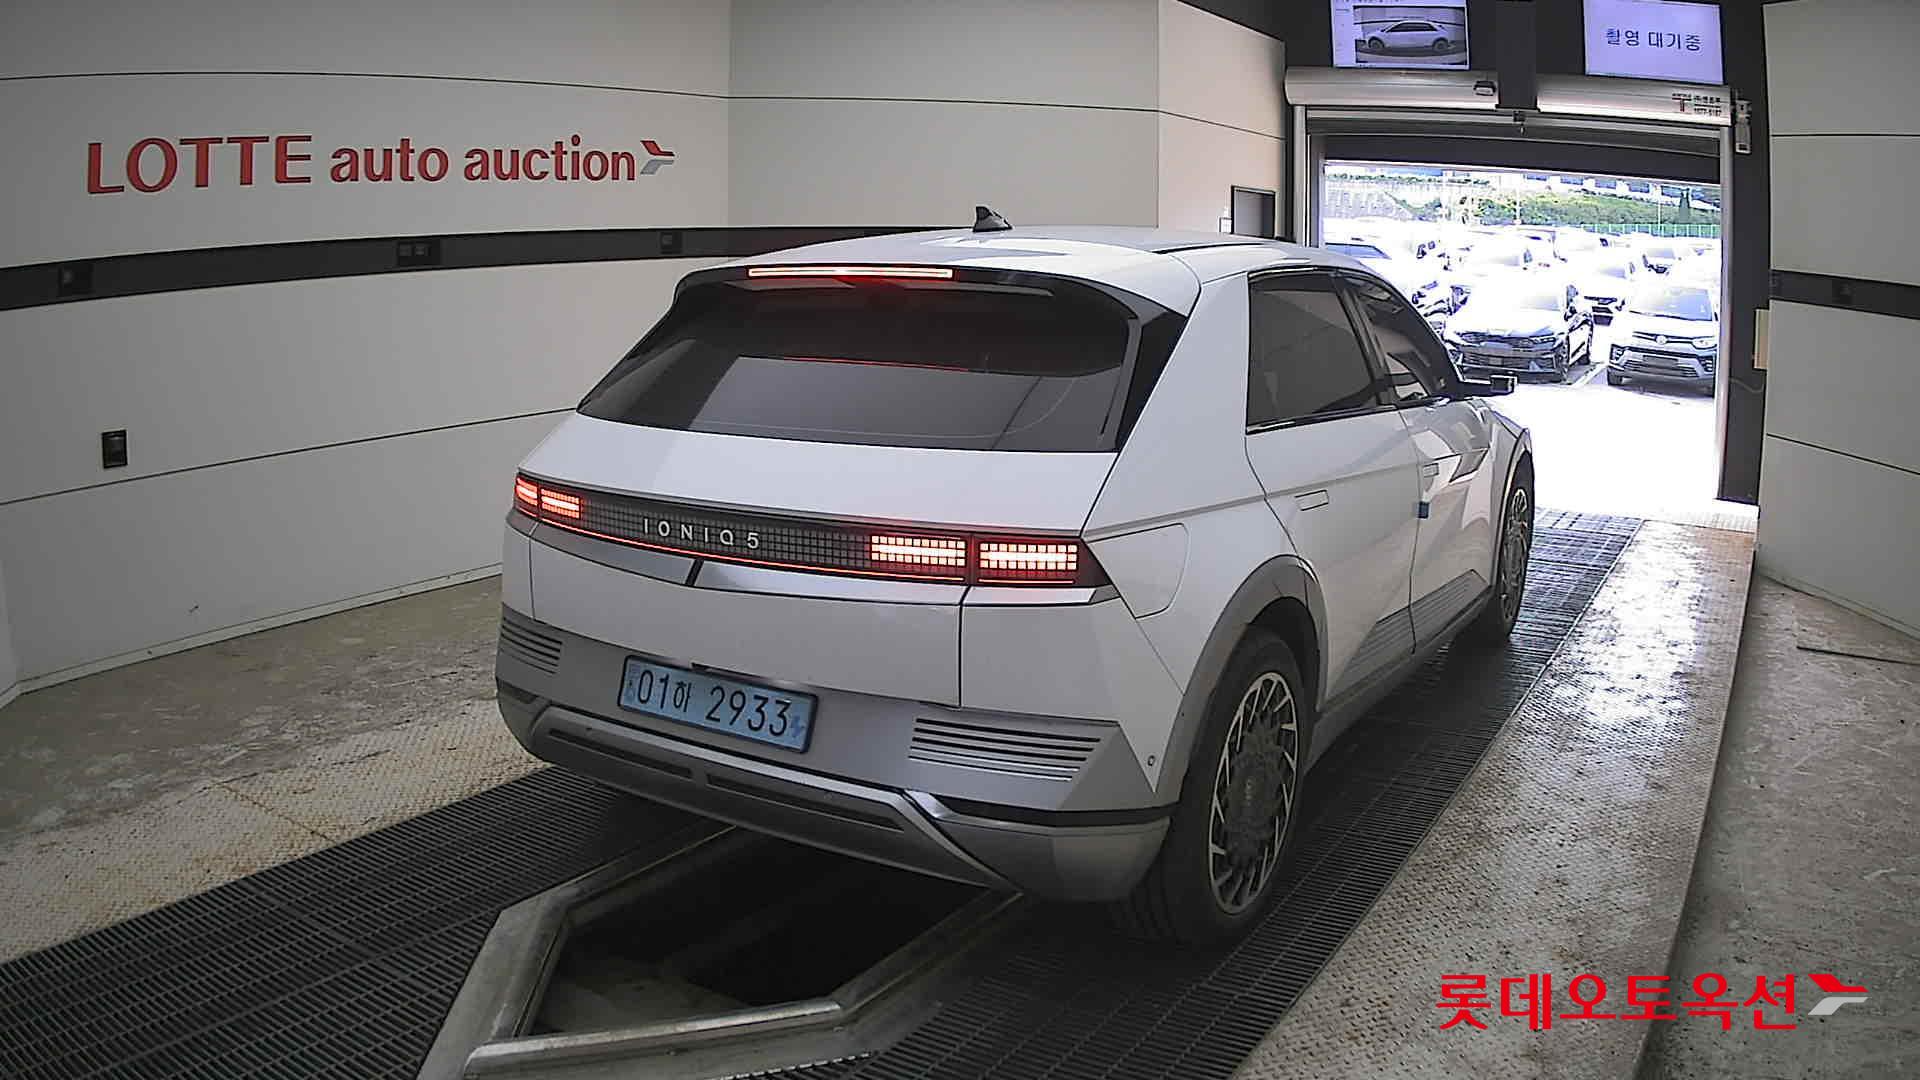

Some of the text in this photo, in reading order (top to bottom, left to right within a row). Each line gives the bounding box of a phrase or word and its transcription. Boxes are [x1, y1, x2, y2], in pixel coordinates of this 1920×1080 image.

[1648, 31, 1702, 52] 대기중
[87, 134, 636, 195] LOTTE auto auction
[705, 685, 792, 737] 2933
